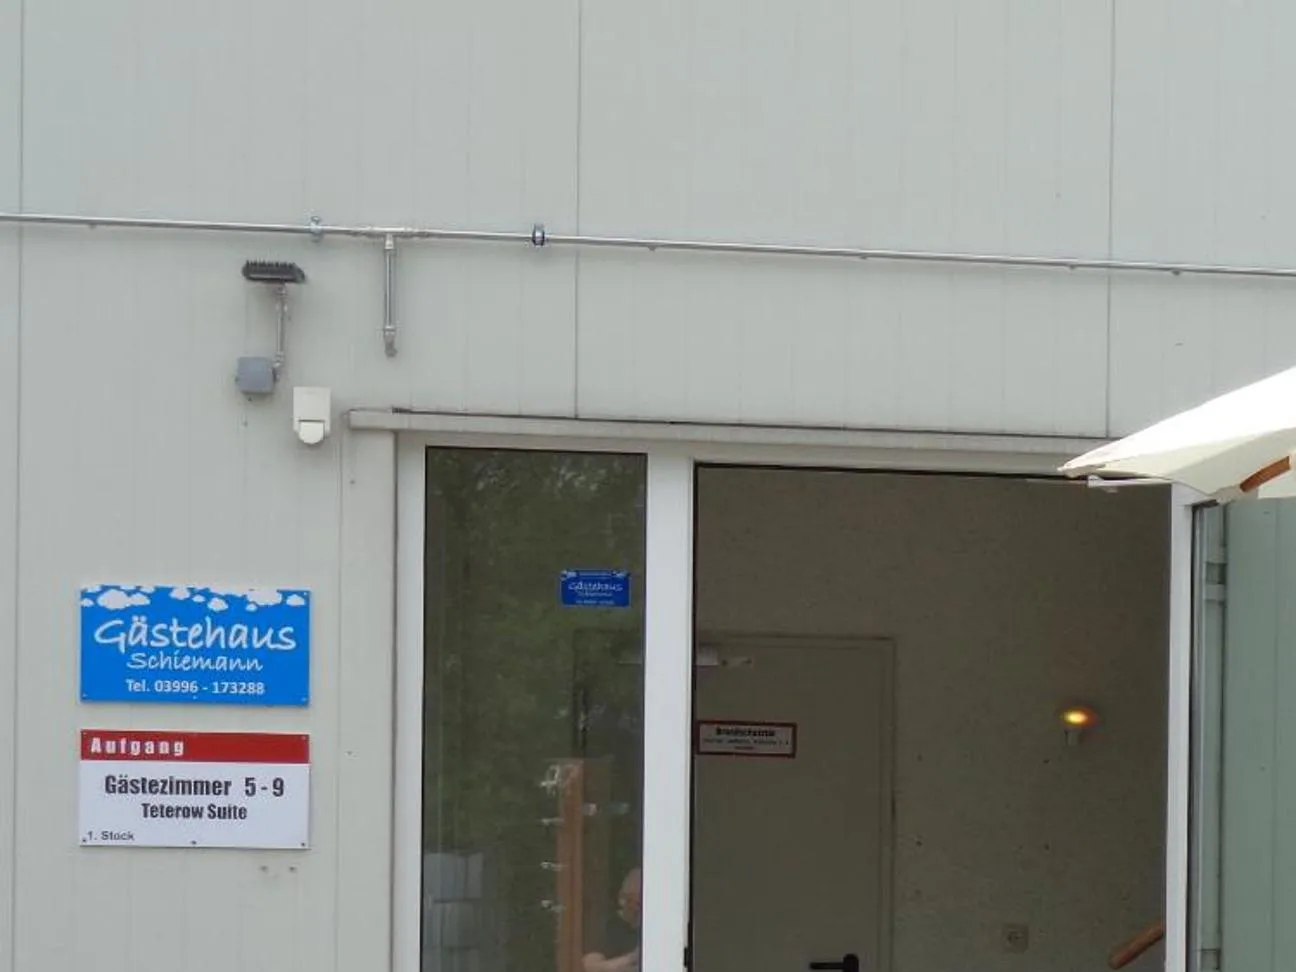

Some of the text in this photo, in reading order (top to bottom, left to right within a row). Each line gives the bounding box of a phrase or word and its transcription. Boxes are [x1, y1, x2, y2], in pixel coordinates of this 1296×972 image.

[93, 615, 297, 654] Gästehaus
[126, 650, 264, 672] Schiemann
[126, 678, 150, 693] Tel.
[154, 680, 199, 694] 03996
[212, 681, 266, 695] 173288
[90, 737, 185, 756] Aufgang
[105, 774, 232, 797] Gästezimmer
[142, 803, 247, 821] Teterow Suite
[101, 831, 134, 842] Stock
